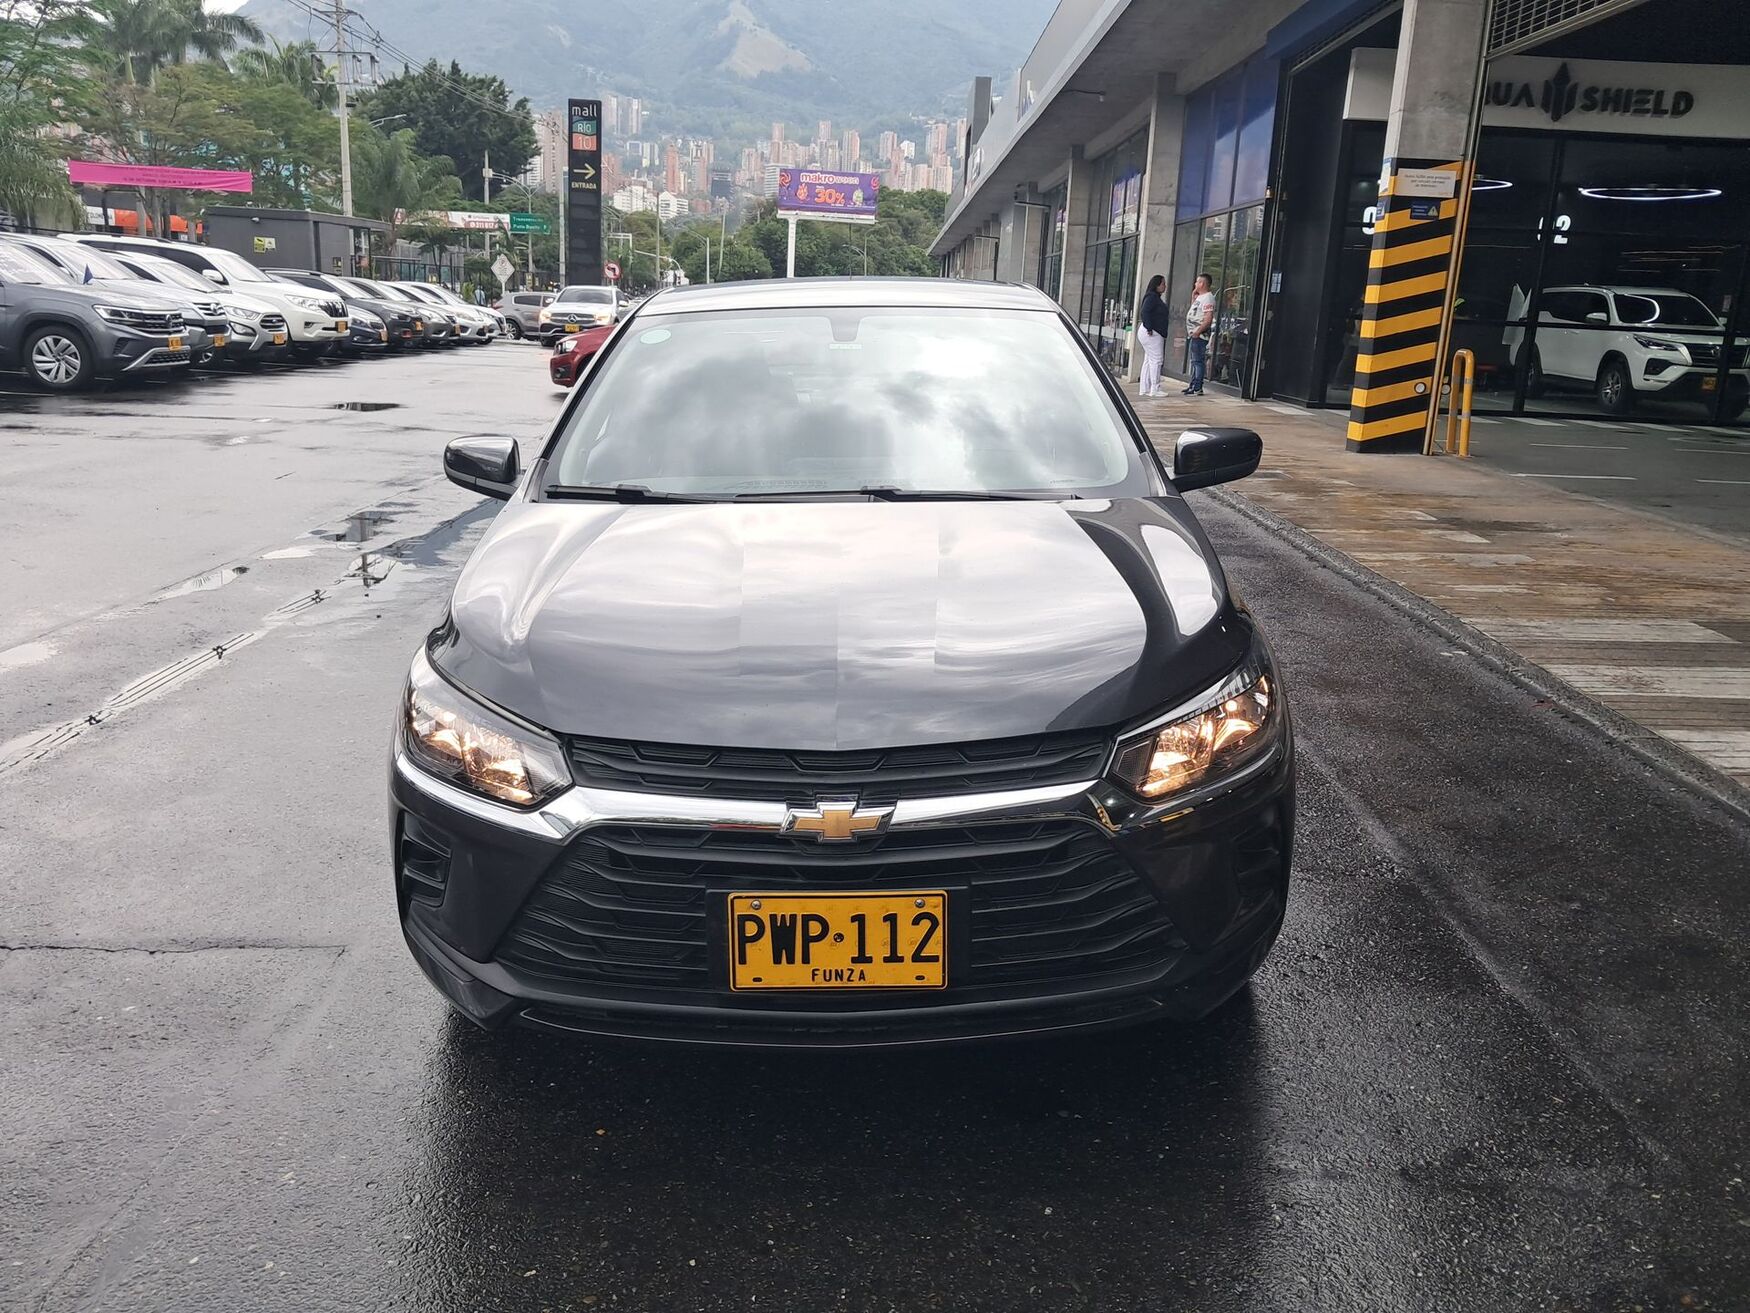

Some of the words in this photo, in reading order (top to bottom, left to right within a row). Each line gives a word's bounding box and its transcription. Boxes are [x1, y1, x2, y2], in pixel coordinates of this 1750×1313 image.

[1580, 86, 1695, 117] SHIELD
[571, 103, 598, 118] mall
[578, 136, 593, 150] 10
[571, 181, 598, 190] ENTRADA
[811, 967, 866, 983] FUNZA
